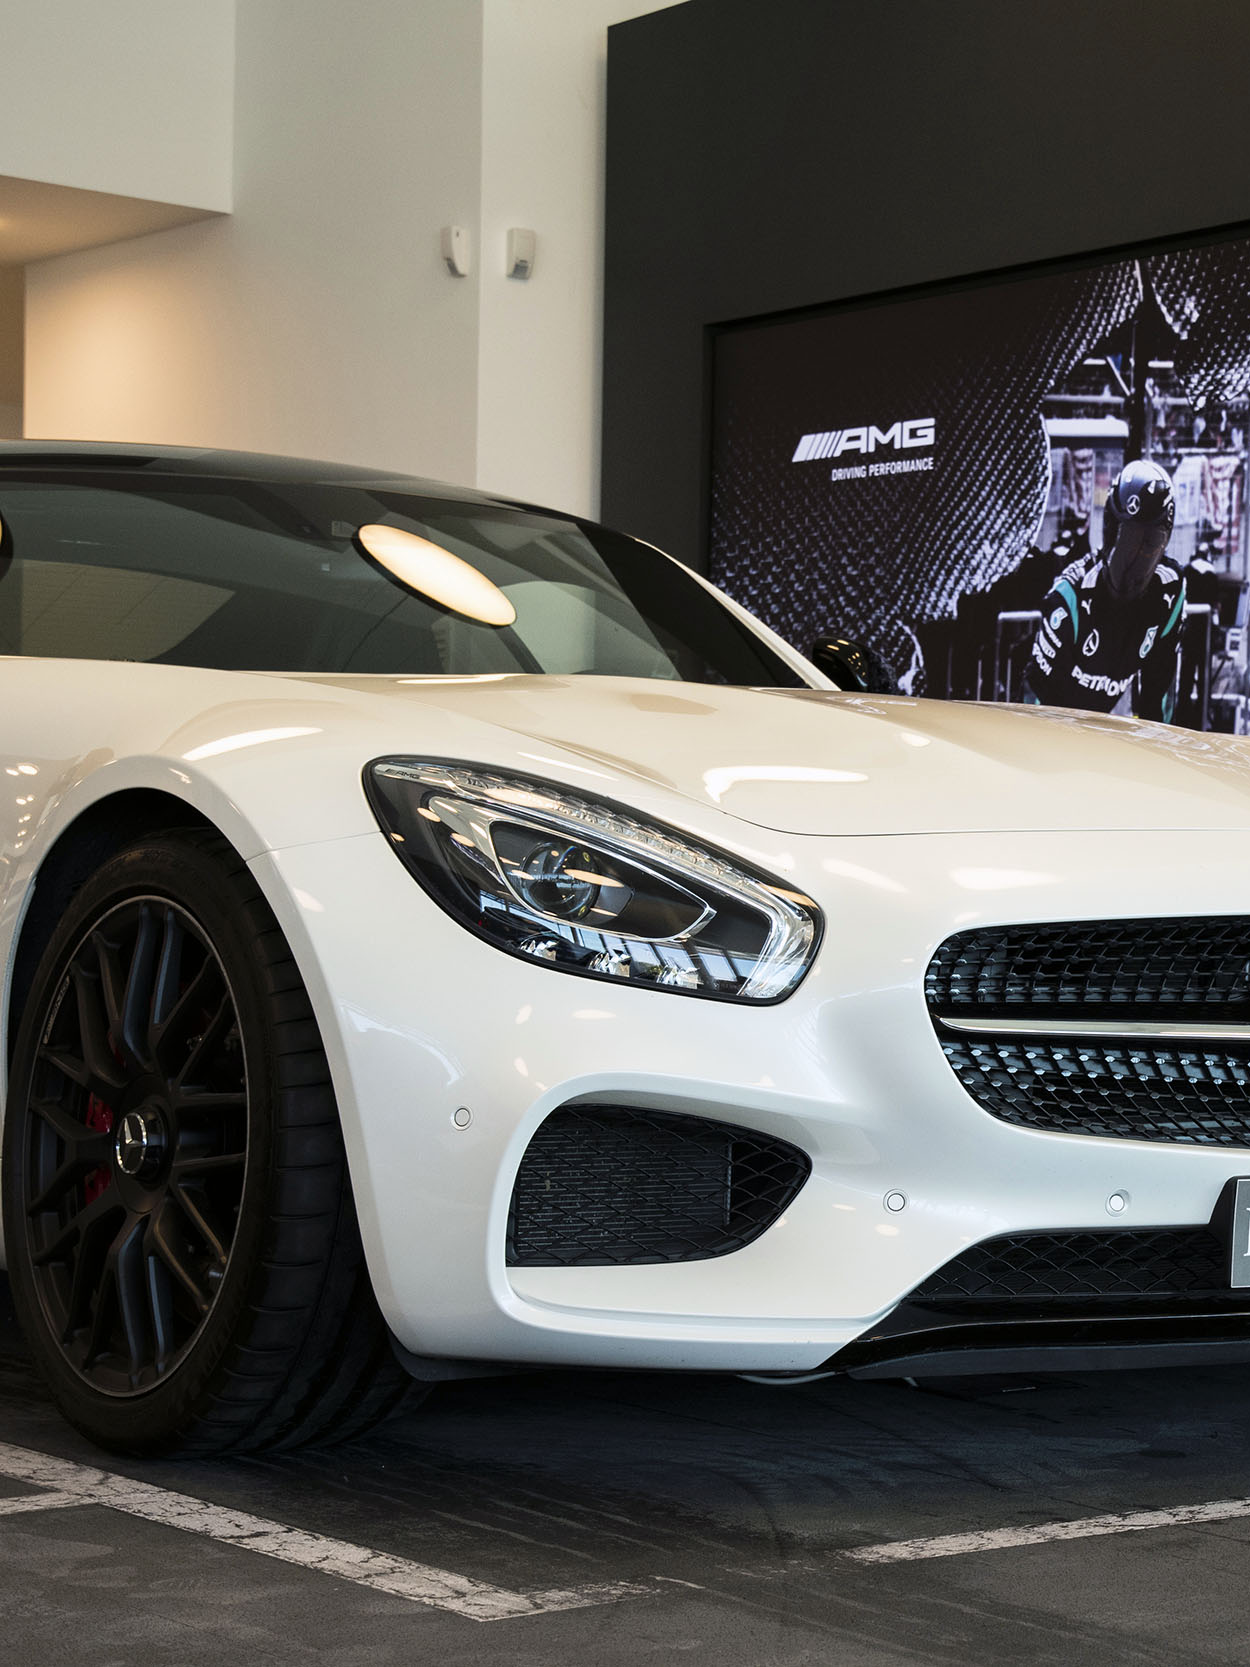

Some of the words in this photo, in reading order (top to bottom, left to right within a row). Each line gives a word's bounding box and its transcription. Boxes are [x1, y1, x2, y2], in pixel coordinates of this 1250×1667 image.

[833, 417, 936, 458] AMG
[831, 466, 867, 482] DRIVING
[868, 457, 935, 476] PERFORMANCE
